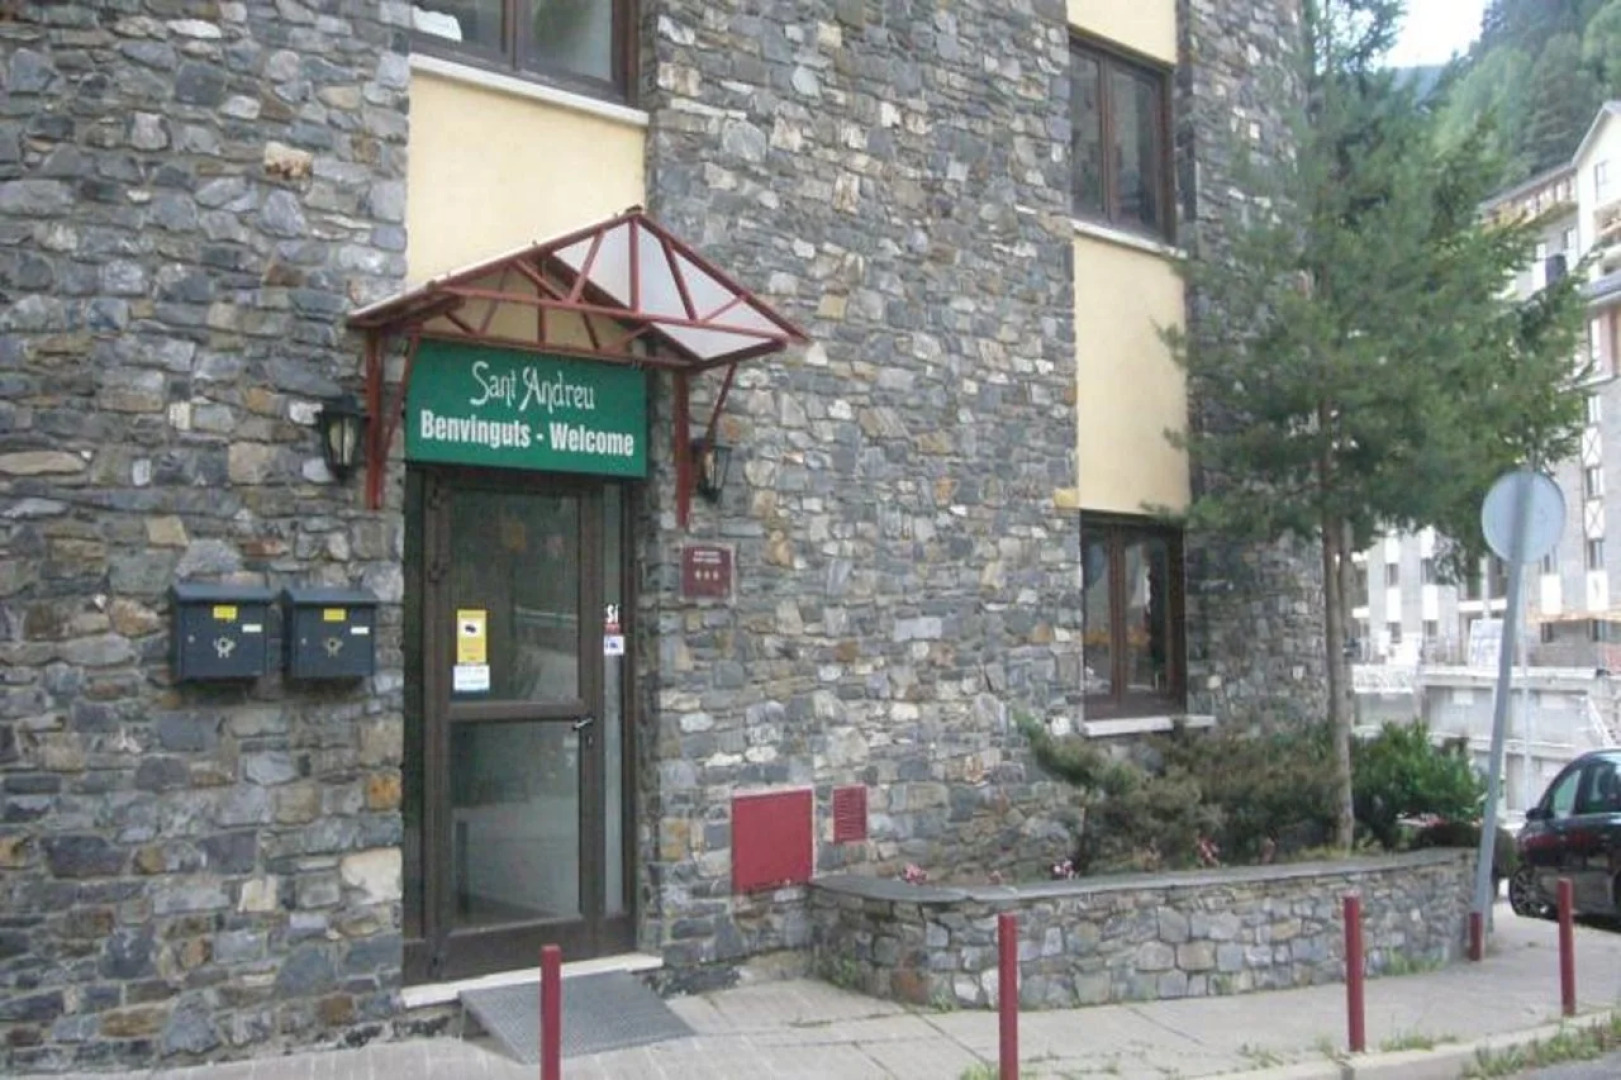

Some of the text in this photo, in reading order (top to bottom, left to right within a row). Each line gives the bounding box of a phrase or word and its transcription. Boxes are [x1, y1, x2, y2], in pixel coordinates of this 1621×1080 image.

[470, 361, 595, 414] Sant Andreu
[420, 409, 531, 448] Benvinguts
[549, 422, 634, 457] Welcome
